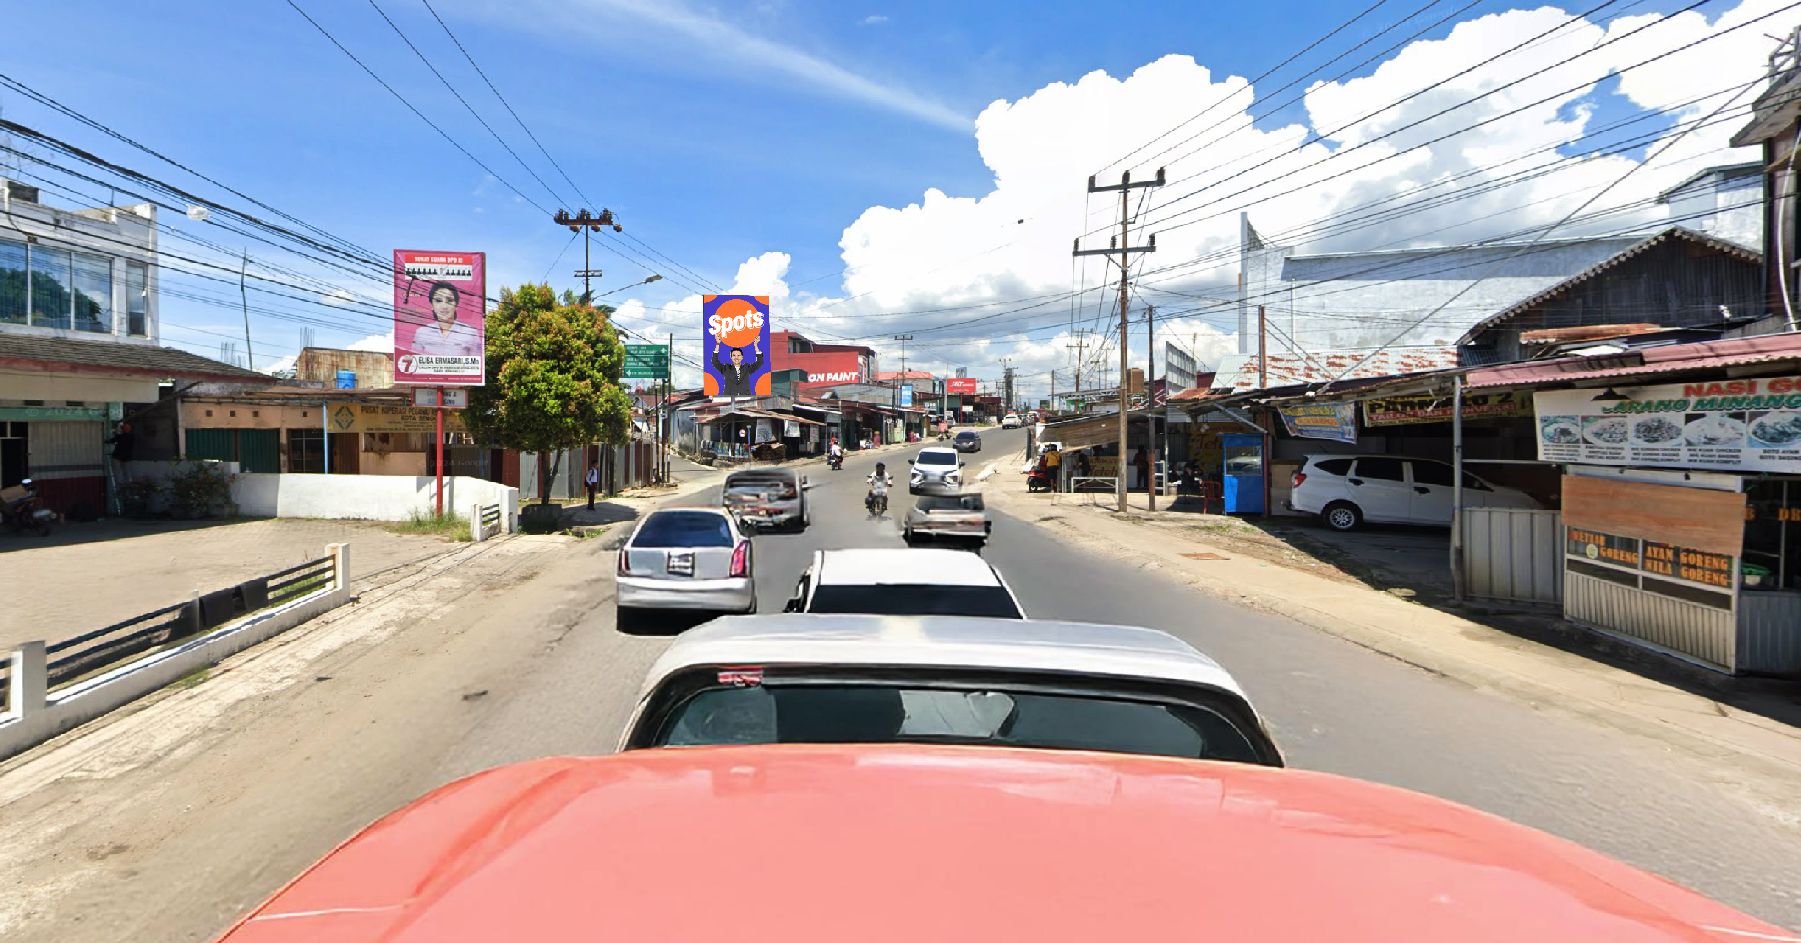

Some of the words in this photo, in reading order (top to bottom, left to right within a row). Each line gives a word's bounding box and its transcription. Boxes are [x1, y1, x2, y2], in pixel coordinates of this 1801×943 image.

[708, 309, 765, 340] Spots
[402, 358, 413, 372] 7
[826, 371, 859, 381] PAINT
[1683, 380, 1758, 398] NASI
[1599, 546, 1639, 564] GORENG
[1680, 552, 1729, 570] GORENG
[1680, 566, 1729, 586] GORENG
